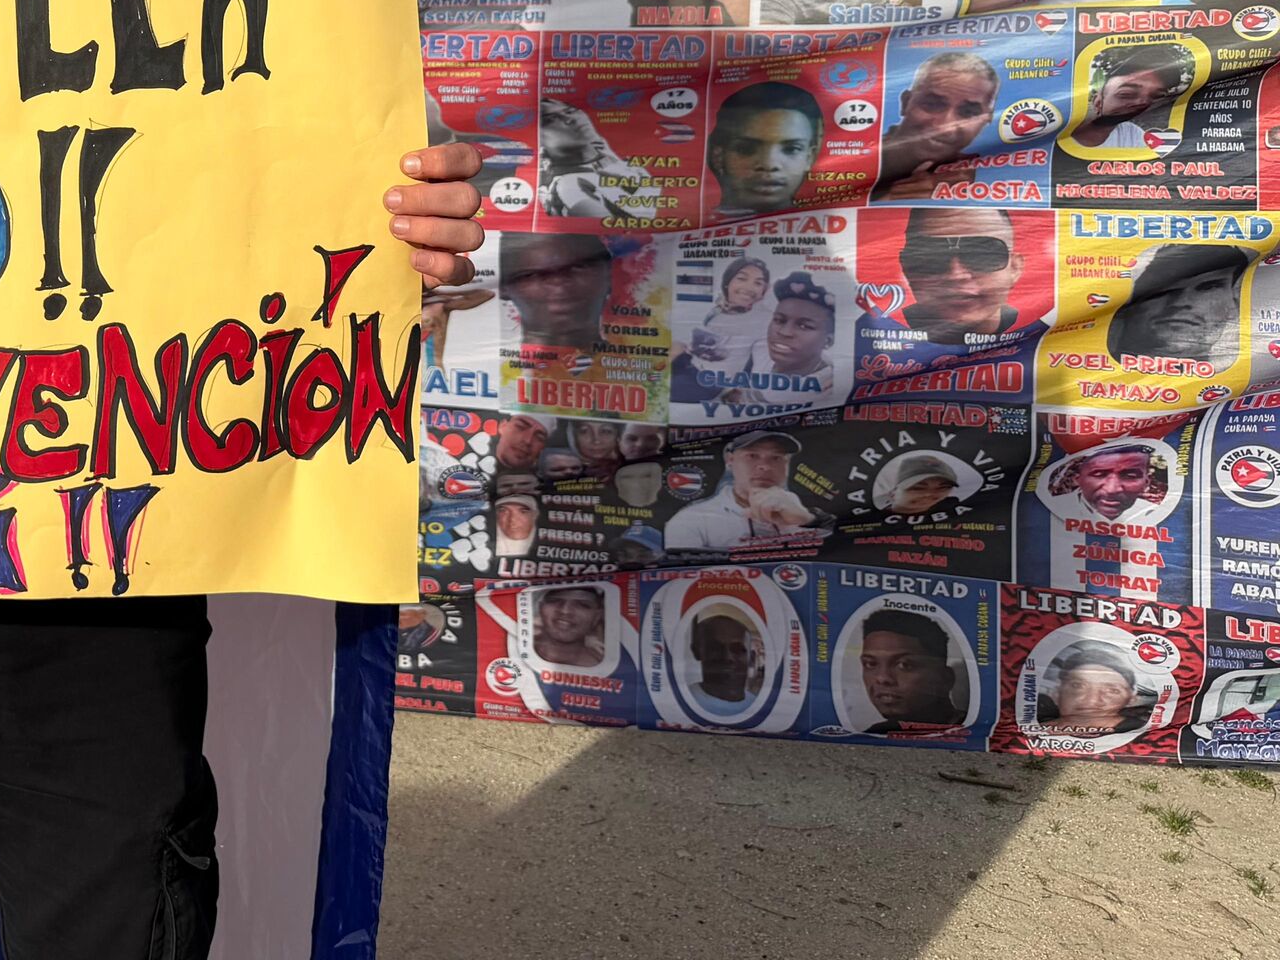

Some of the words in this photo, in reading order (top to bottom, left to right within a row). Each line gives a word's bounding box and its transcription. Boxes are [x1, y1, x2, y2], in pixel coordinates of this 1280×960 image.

[829, 3, 942, 25] Salsines
[1078, 9, 1232, 34] LIBERTAD
[899, 16, 1031, 38] LIBERTAD
[726, 31, 883, 58] LIBERTAD
[1105, 36, 1116, 45] LA
[1118, 35, 1146, 45] PAPAYA
[1148, 33, 1176, 42] CUBANA
[551, 34, 705, 61] LIBERTAD
[1217, 48, 1245, 60] GRUPO
[1005, 59, 1030, 69] GRUPO
[1221, 60, 1263, 71] HABANERO
[666, 90, 685, 98] 17
[1227, 88, 1249, 96] JULIO
[656, 99, 693, 109] AÑOS
[850, 104, 866, 112] 17
[1192, 100, 1238, 111] SENTENCIA
[1242, 100, 1252, 109] 10
[1004, 102, 1030, 126] PATRIA
[1209, 112, 1232, 123] AÑOS
[1196, 142, 1207, 152] LA
[1209, 142, 1245, 152] HABANA
[1087, 161, 1166, 176] CARLOS
[1171, 161, 1225, 177] PAUL
[504, 182, 521, 191] 17
[600, 176, 699, 188] IDALBERTO
[932, 181, 1043, 201] ACOSTA
[1056, 184, 1171, 200] MICHELENA
[1178, 186, 1258, 200] VALDEZ
[494, 194, 528, 205] AÑOS
[615, 196, 679, 208] JOVER
[602, 217, 692, 228] CARDOZA
[681, 215, 847, 242] LIBERTAD
[1071, 213, 1273, 241] LIBERTAD
[1066, 255, 1095, 265] GRUPO
[612, 306, 651, 317] YOAN
[603, 324, 658, 337] TORRES
[860, 328, 885, 339] GRUPO
[592, 343, 669, 357] MARTÍNEZ
[872, 341, 902, 351] CUBANA
[601, 357, 628, 369] GRUPO
[1049, 353, 1114, 371] YOEL
[1121, 353, 1216, 377] PRIETO
[695, 370, 822, 393] CLAUDIA
[852, 361, 1024, 401] LIBERTAD
[516, 378, 648, 414] LIBERTAD
[1078, 381, 1180, 403] TAMAYO
[700, 401, 721, 418] Y
[843, 404, 988, 429] LIBERTAD
[1050, 412, 1191, 435] LIBERTAD
[1228, 415, 1239, 424] LA
[1242, 414, 1275, 423] PAPAYA
[1224, 424, 1258, 433] CUBANA
[548, 510, 594, 525] ESTÁN
[884, 504, 973, 525] CUBA
[538, 528, 591, 542] PRESOS
[1064, 518, 1174, 543] PASCUAL
[536, 545, 609, 561] EXIGIMOS
[1073, 542, 1165, 567] ZÚÑIGA
[498, 557, 617, 577] LIBERTAD
[840, 568, 969, 599] LIBERTAD
[1076, 570, 1162, 593] TOIRAT
[883, 598, 936, 613] Inocente
[1019, 590, 1182, 628] LIBERTAD
[540, 670, 624, 691] DUNIESKY
[561, 694, 600, 709] RUIZ
[1028, 739, 1095, 752] VARGAS
